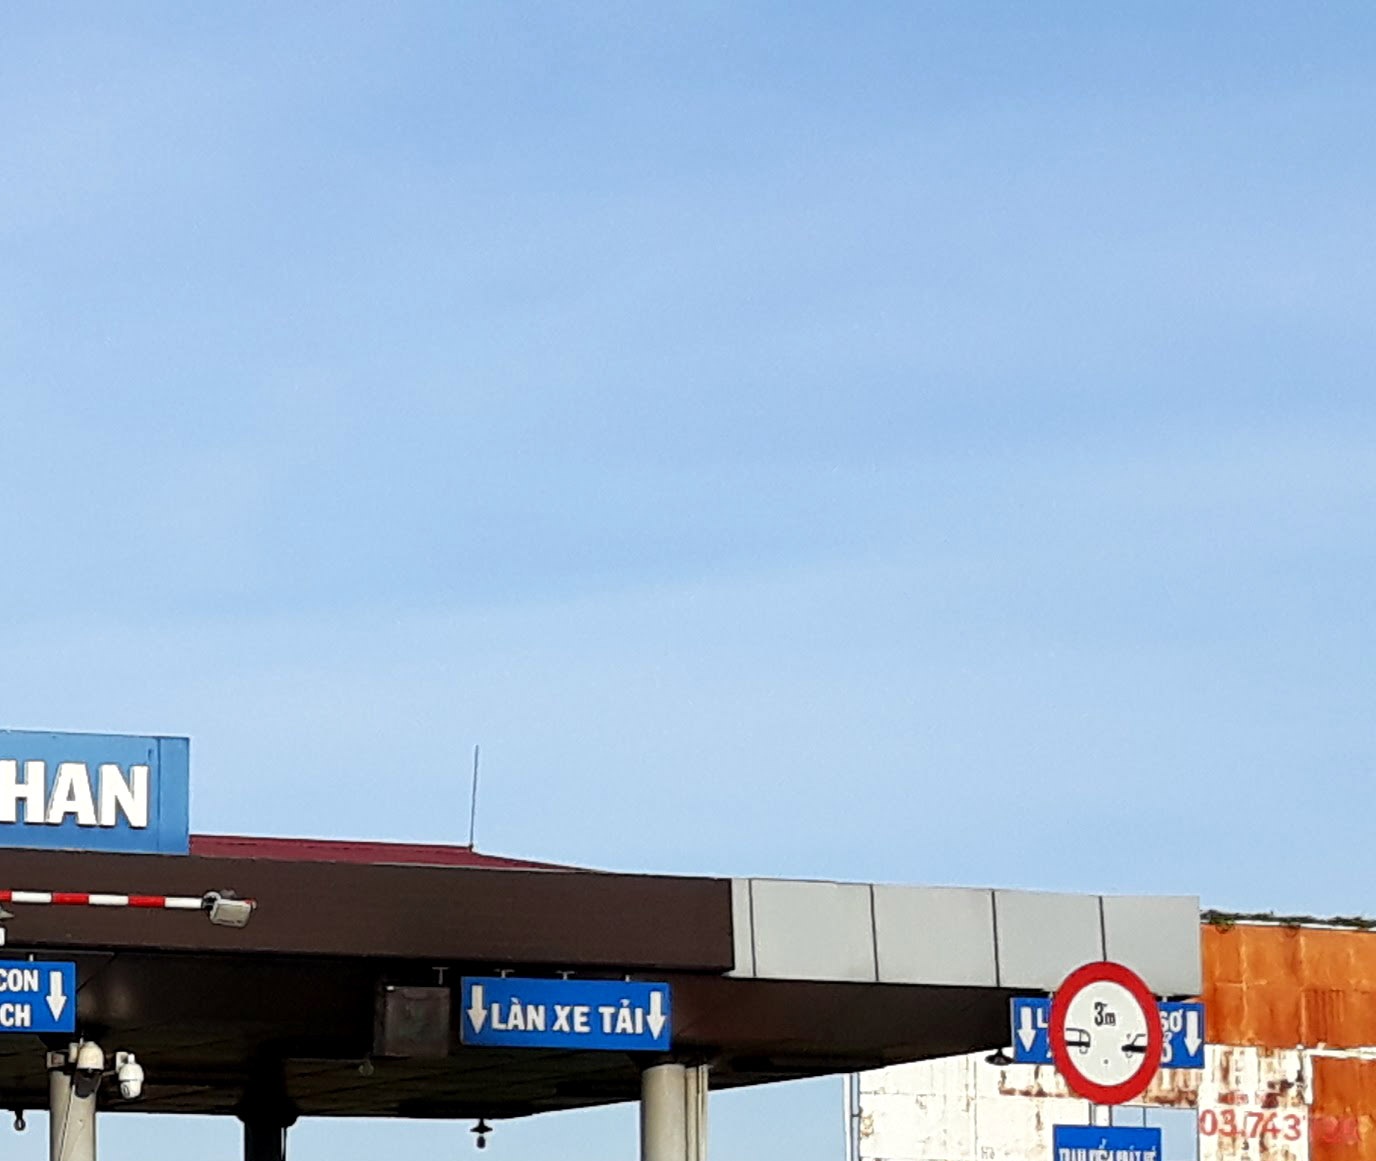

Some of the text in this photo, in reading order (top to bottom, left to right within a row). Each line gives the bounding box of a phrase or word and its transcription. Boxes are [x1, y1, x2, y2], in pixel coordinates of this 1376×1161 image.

[491, 997, 644, 1034] LÀN XE TẢI
